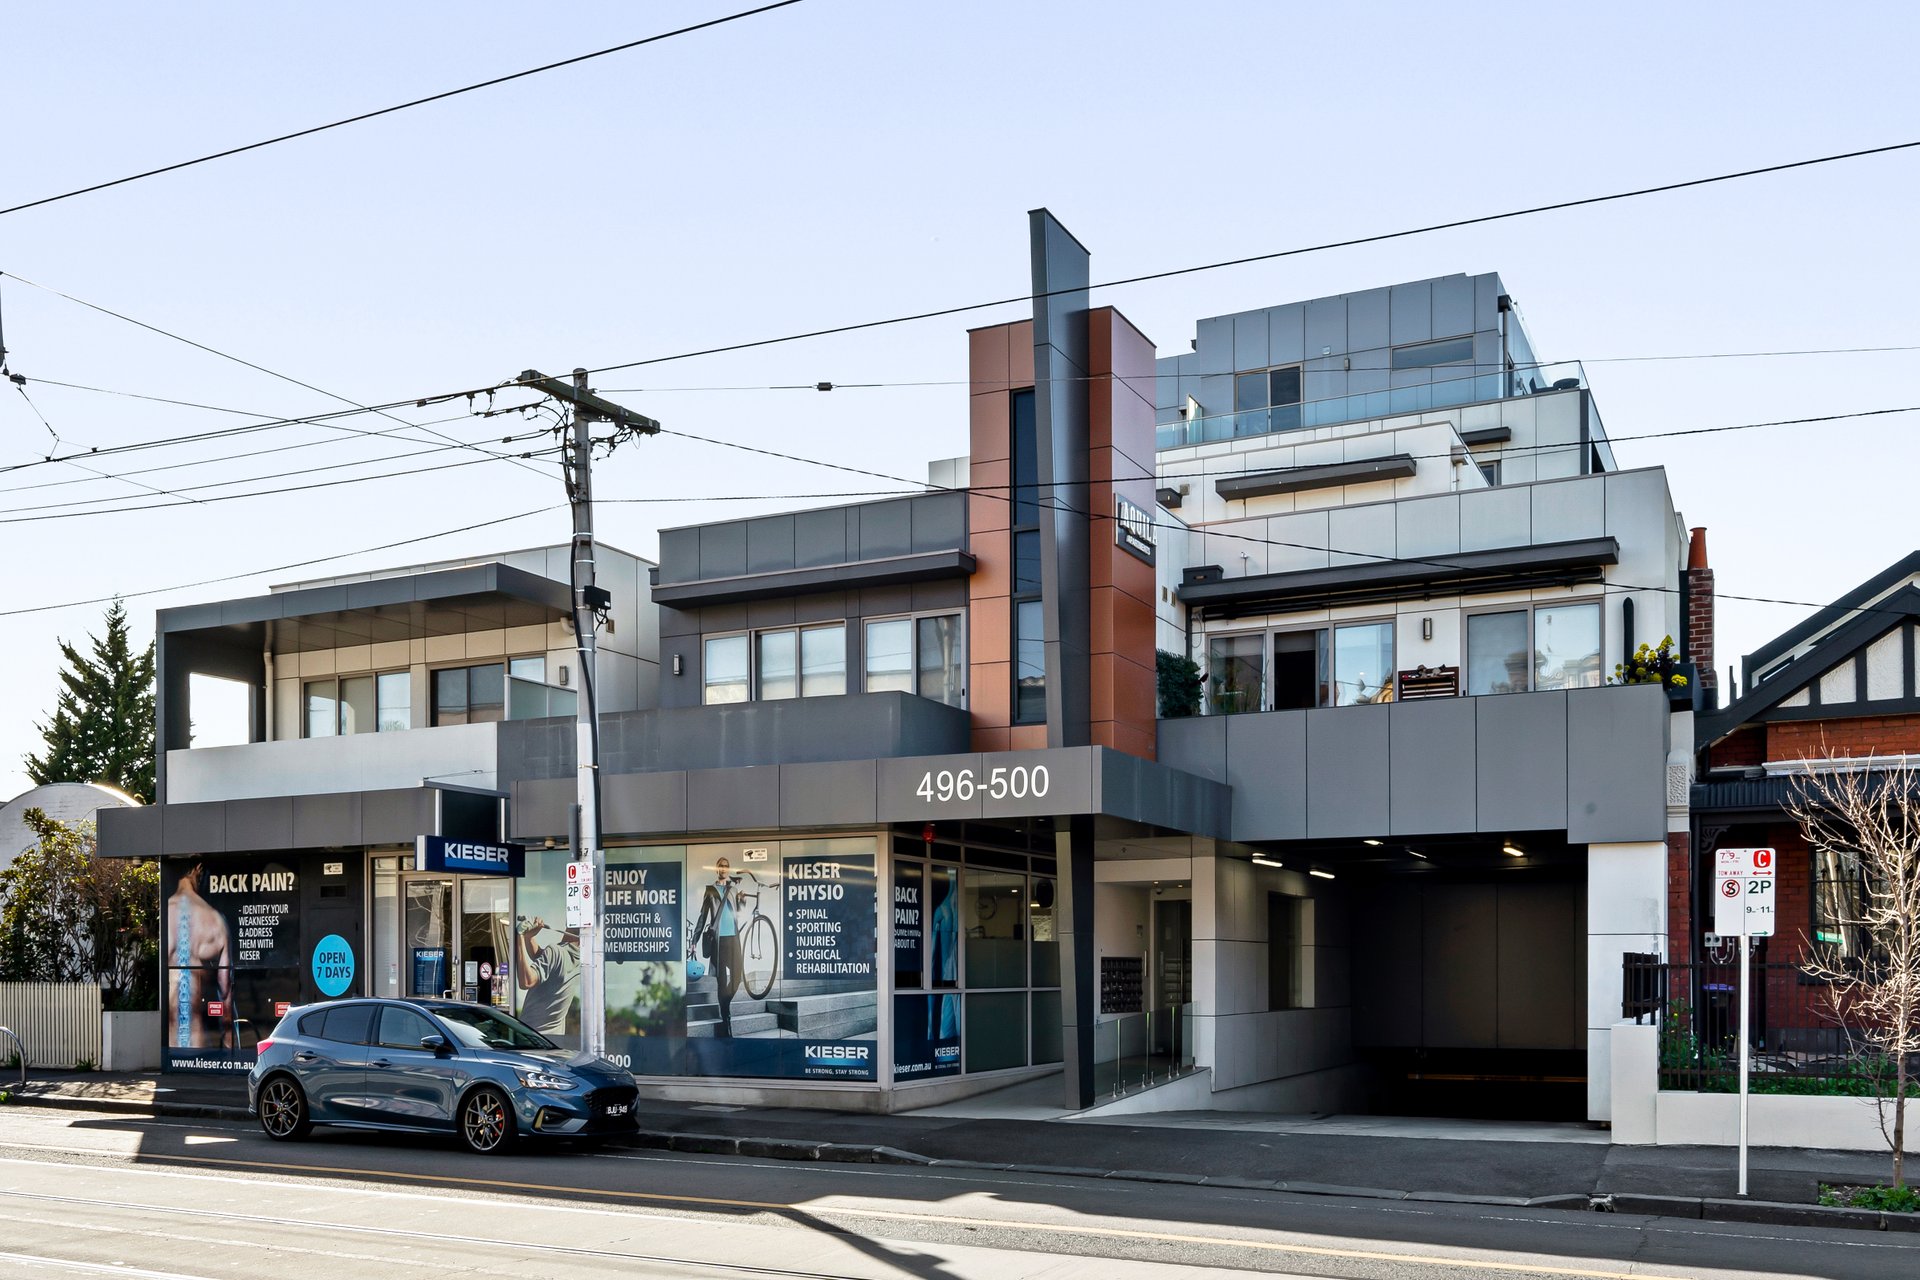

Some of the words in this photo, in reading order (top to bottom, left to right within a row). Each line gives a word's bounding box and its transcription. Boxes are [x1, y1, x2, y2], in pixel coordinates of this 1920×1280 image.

[916, 765, 1049, 802] 496-500
[444, 842, 508, 862] KIESER
[788, 863, 840, 880] KIESER
[209, 874, 248, 893] BACK
[252, 872, 295, 892] PAIN?
[605, 870, 648, 886] ENJOY
[568, 887, 578, 897] 2P
[788, 885, 844, 900] PHYSIO
[1748, 880, 1771, 894] 2P
[605, 890, 632, 906] LIFE
[636, 889, 676, 905] MORE
[895, 886, 917, 903] BACK
[243, 905, 270, 914] IDENTIFY
[271, 904, 289, 914] YOUR
[796, 909, 828, 919] SPINAL
[239, 916, 279, 925] WEAKNESSES
[605, 913, 651, 924] STRENGTH
[654, 913, 661, 924] &
[895, 908, 919, 925] PAIN?
[239, 928, 244, 937] &
[245, 928, 273, 937] ADDRESS
[605, 927, 672, 938] CONDITIONING
[796, 922, 841, 933] SPORTING
[239, 940, 256, 949] THEM
[257, 939, 273, 948] WITH
[605, 941, 670, 953] MEMBERSHIPS
[796, 936, 836, 946] INJURIES
[240, 951, 260, 960] KIESER
[319, 952, 346, 964] OPEN
[796, 950, 841, 960] SURGICAL
[317, 967, 322, 978] 7
[325, 966, 351, 978] DAYS
[796, 963, 870, 974] REHABILITATION
[805, 1046, 868, 1059] KIESER
[935, 1046, 960, 1057] KIESER
[172, 1058, 254, 1070] www.kieser.com.au
